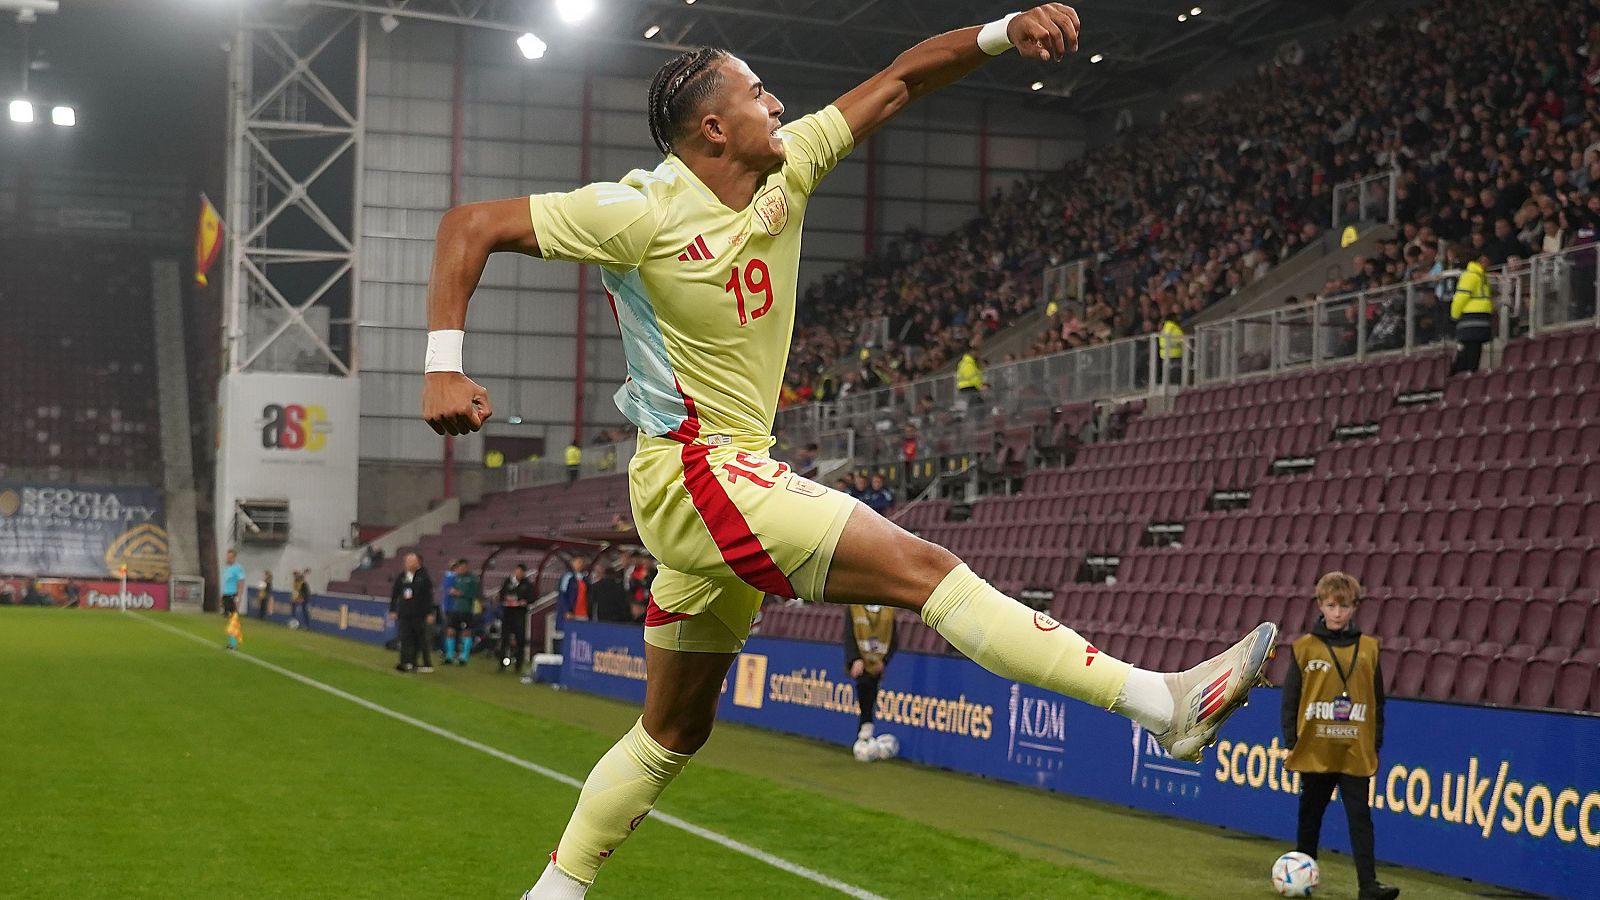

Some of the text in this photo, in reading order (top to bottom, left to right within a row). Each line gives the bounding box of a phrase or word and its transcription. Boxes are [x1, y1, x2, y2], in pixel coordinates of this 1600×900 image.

[725, 258, 774, 326] 19
[262, 404, 327, 451] asc
[87, 590, 154, 609] FanHub
[1021, 697, 1065, 741] KDM
